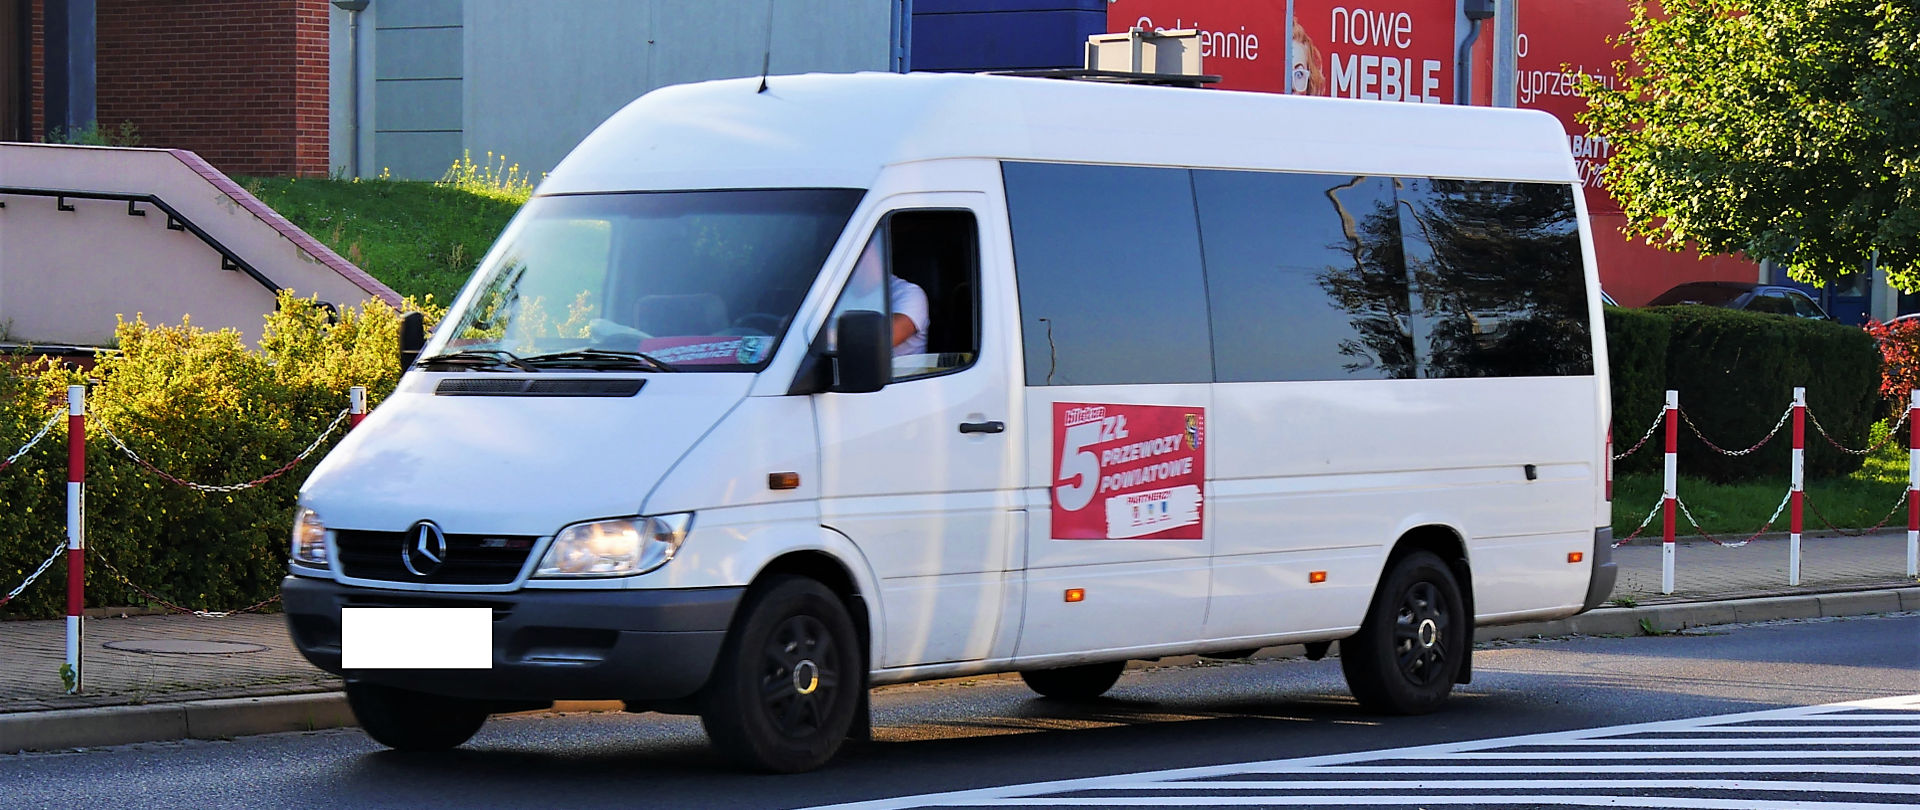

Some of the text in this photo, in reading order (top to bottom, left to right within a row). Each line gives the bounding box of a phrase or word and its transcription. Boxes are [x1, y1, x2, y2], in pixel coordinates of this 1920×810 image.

[1137, 16, 1259, 60] ennie
[1331, 7, 1412, 49] nowe
[1331, 52, 1441, 103] MEBLE
[1515, 64, 1614, 107] yprzedży
[1566, 134, 1610, 158] BATY
[1575, 158, 1608, 188] 0%
[1056, 414, 1129, 512] 5 ZŁ
[1101, 434, 1183, 467] PRZEWOZY
[1100, 456, 1193, 493] POWIATOWE
